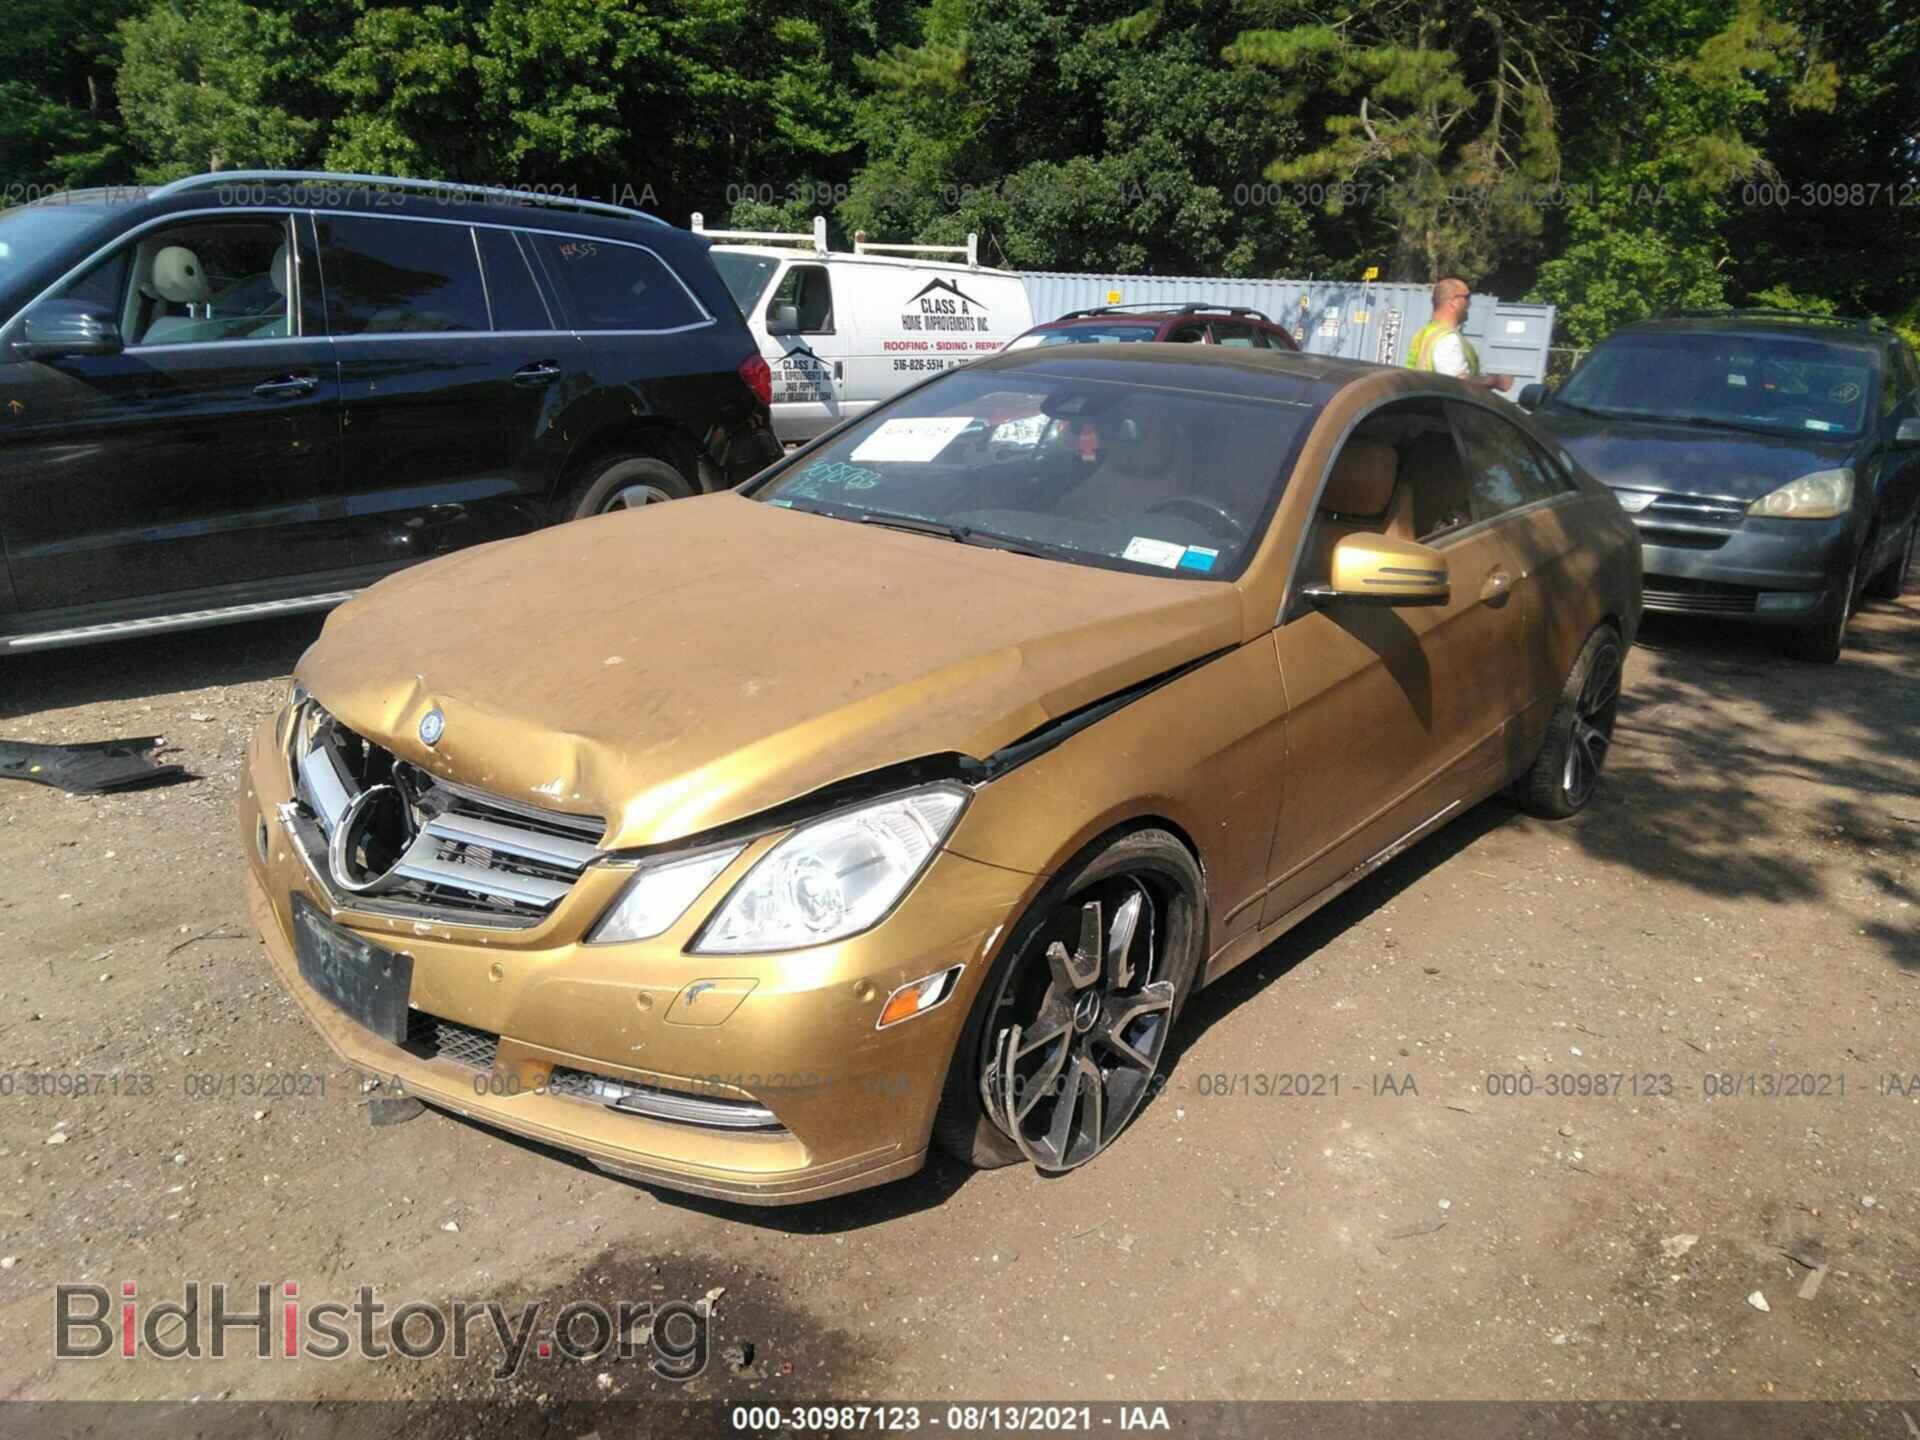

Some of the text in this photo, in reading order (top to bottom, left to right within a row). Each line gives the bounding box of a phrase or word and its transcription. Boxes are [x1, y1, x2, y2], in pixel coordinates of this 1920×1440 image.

[920, 298, 970, 315] CLASS A
[902, 315, 922, 330] HOME
[924, 315, 975, 331] IMPROVEMENTS
[883, 341, 929, 351] ROOFING
[935, 341, 968, 351] SIDING
[783, 360, 819, 370] CLASS A
[893, 358, 944, 371] 516-826-5514
